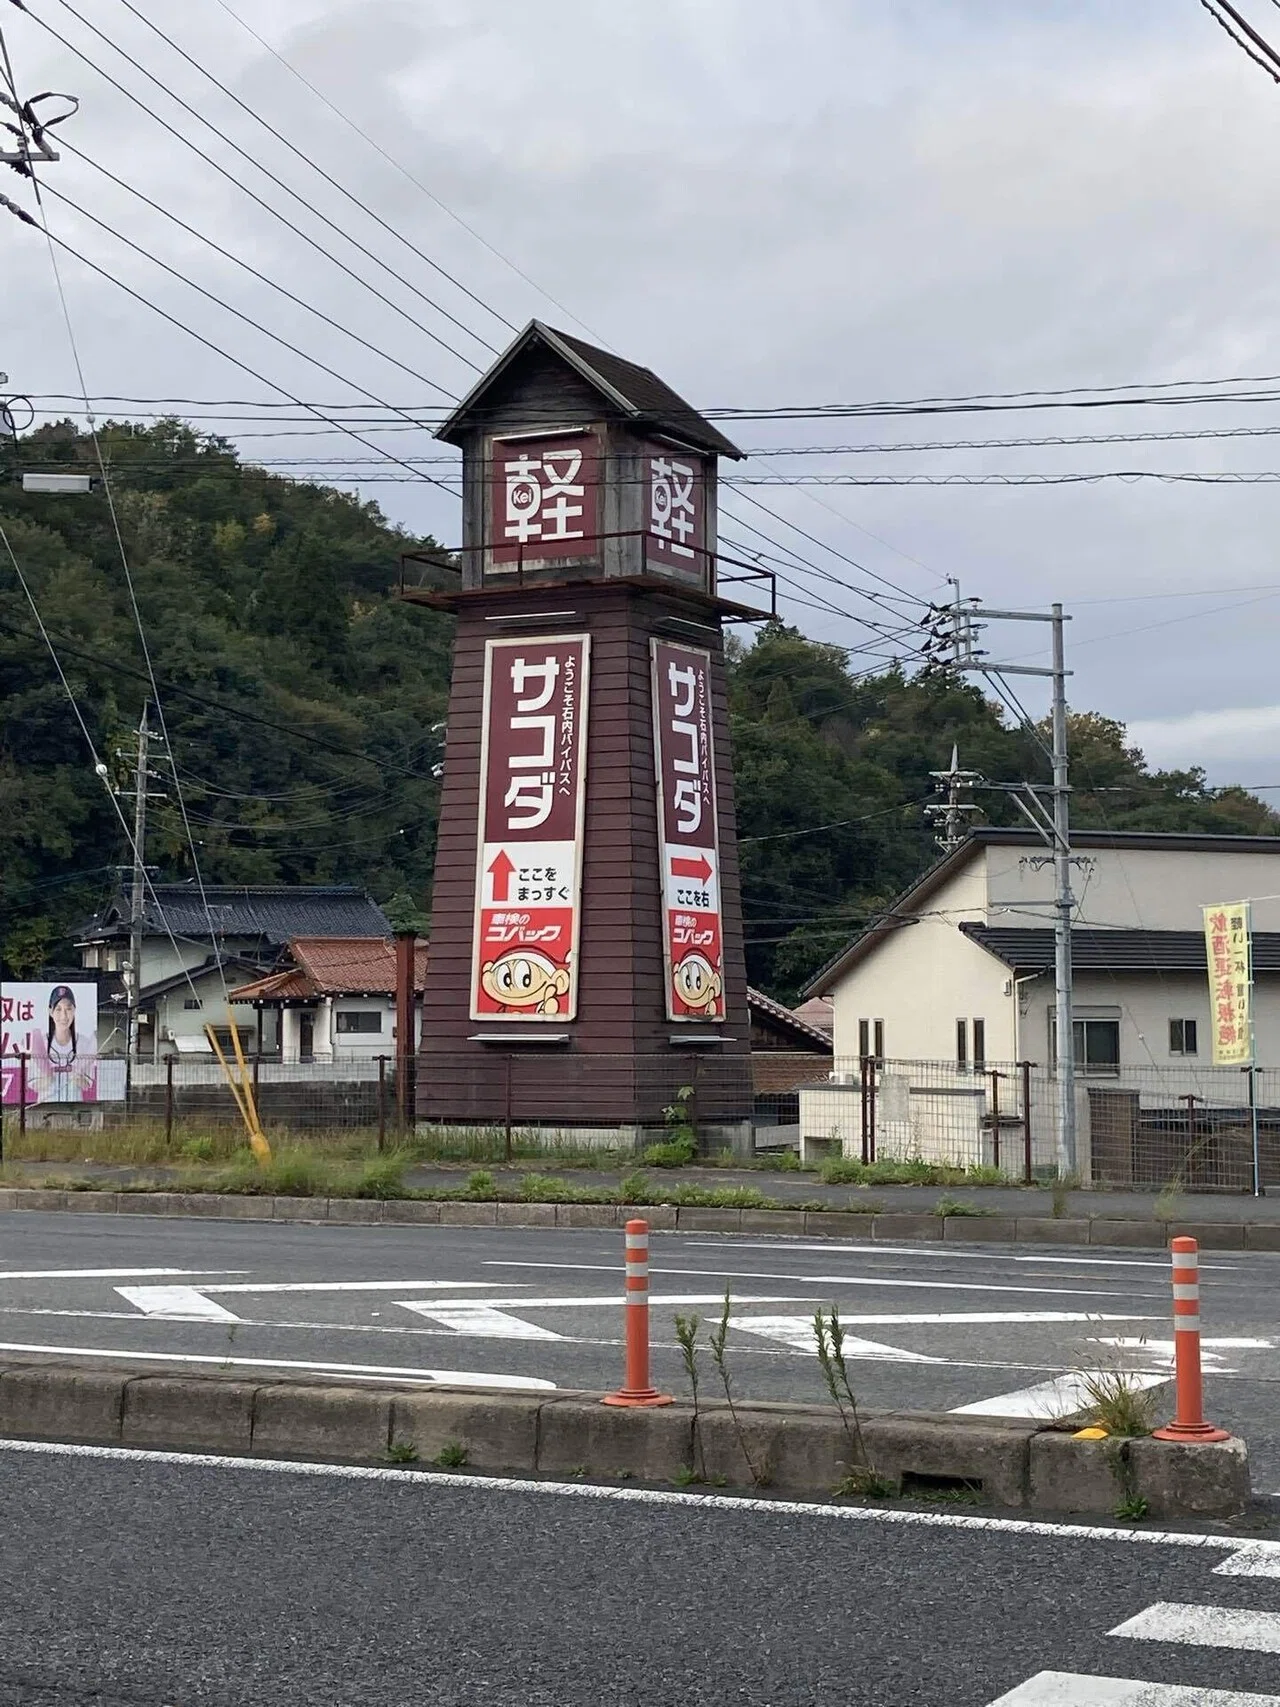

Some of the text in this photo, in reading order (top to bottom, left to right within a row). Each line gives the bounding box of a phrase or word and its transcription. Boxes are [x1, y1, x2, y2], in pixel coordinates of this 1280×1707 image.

[504, 448, 585, 543] 軽
[650, 457, 695, 559] 軽
[559, 655, 577, 796] ようこそ石内バイパスへ
[504, 656, 560, 830] サコダ
[668, 661, 702, 834] サコダ
[518, 867, 557, 882] ここを
[517, 886, 570, 901] まっすぐ
[676, 888, 710, 908] ここを右
[491, 912, 531, 926] 車検の
[484, 925, 562, 942] コバック
[672, 928, 714, 945] コバック
